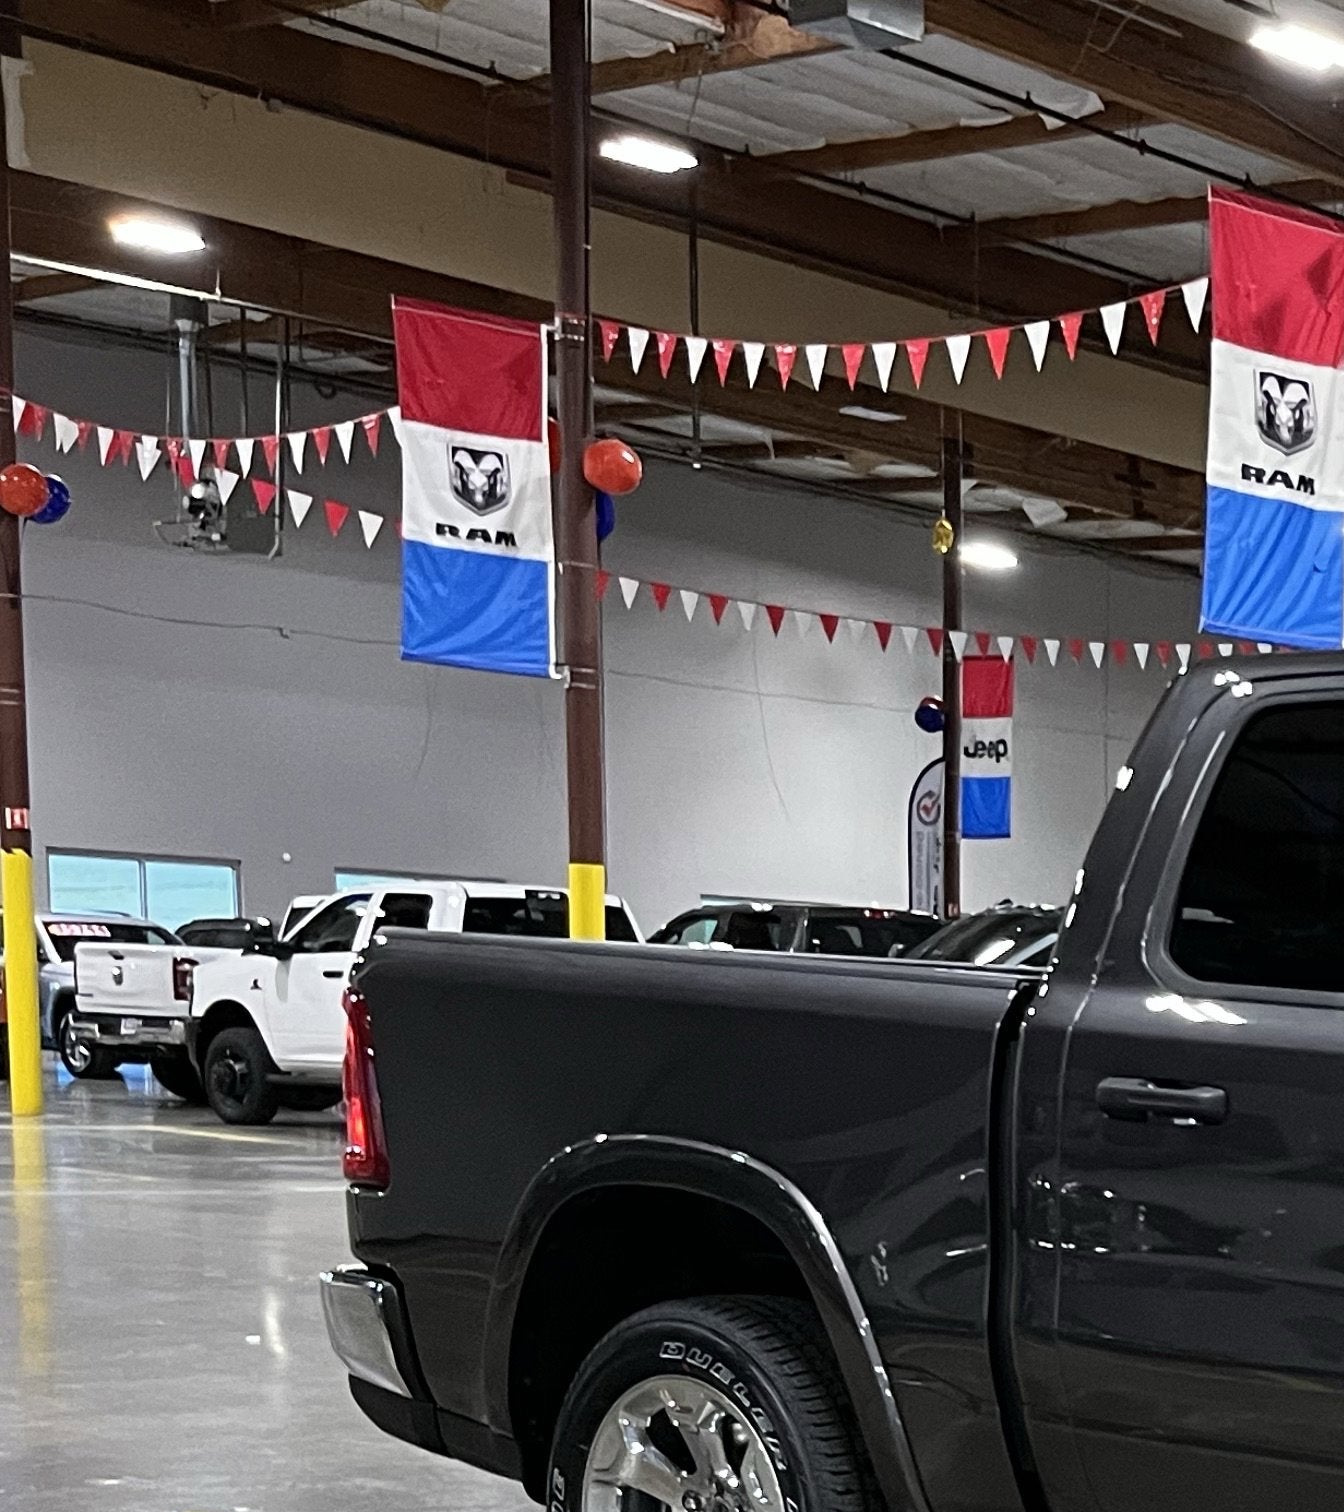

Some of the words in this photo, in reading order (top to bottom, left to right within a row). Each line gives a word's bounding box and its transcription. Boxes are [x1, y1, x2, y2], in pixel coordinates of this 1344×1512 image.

[1240, 463, 1316, 496] RAM
[435, 522, 518, 548] RAM
[963, 736, 1008, 763] Jeep
